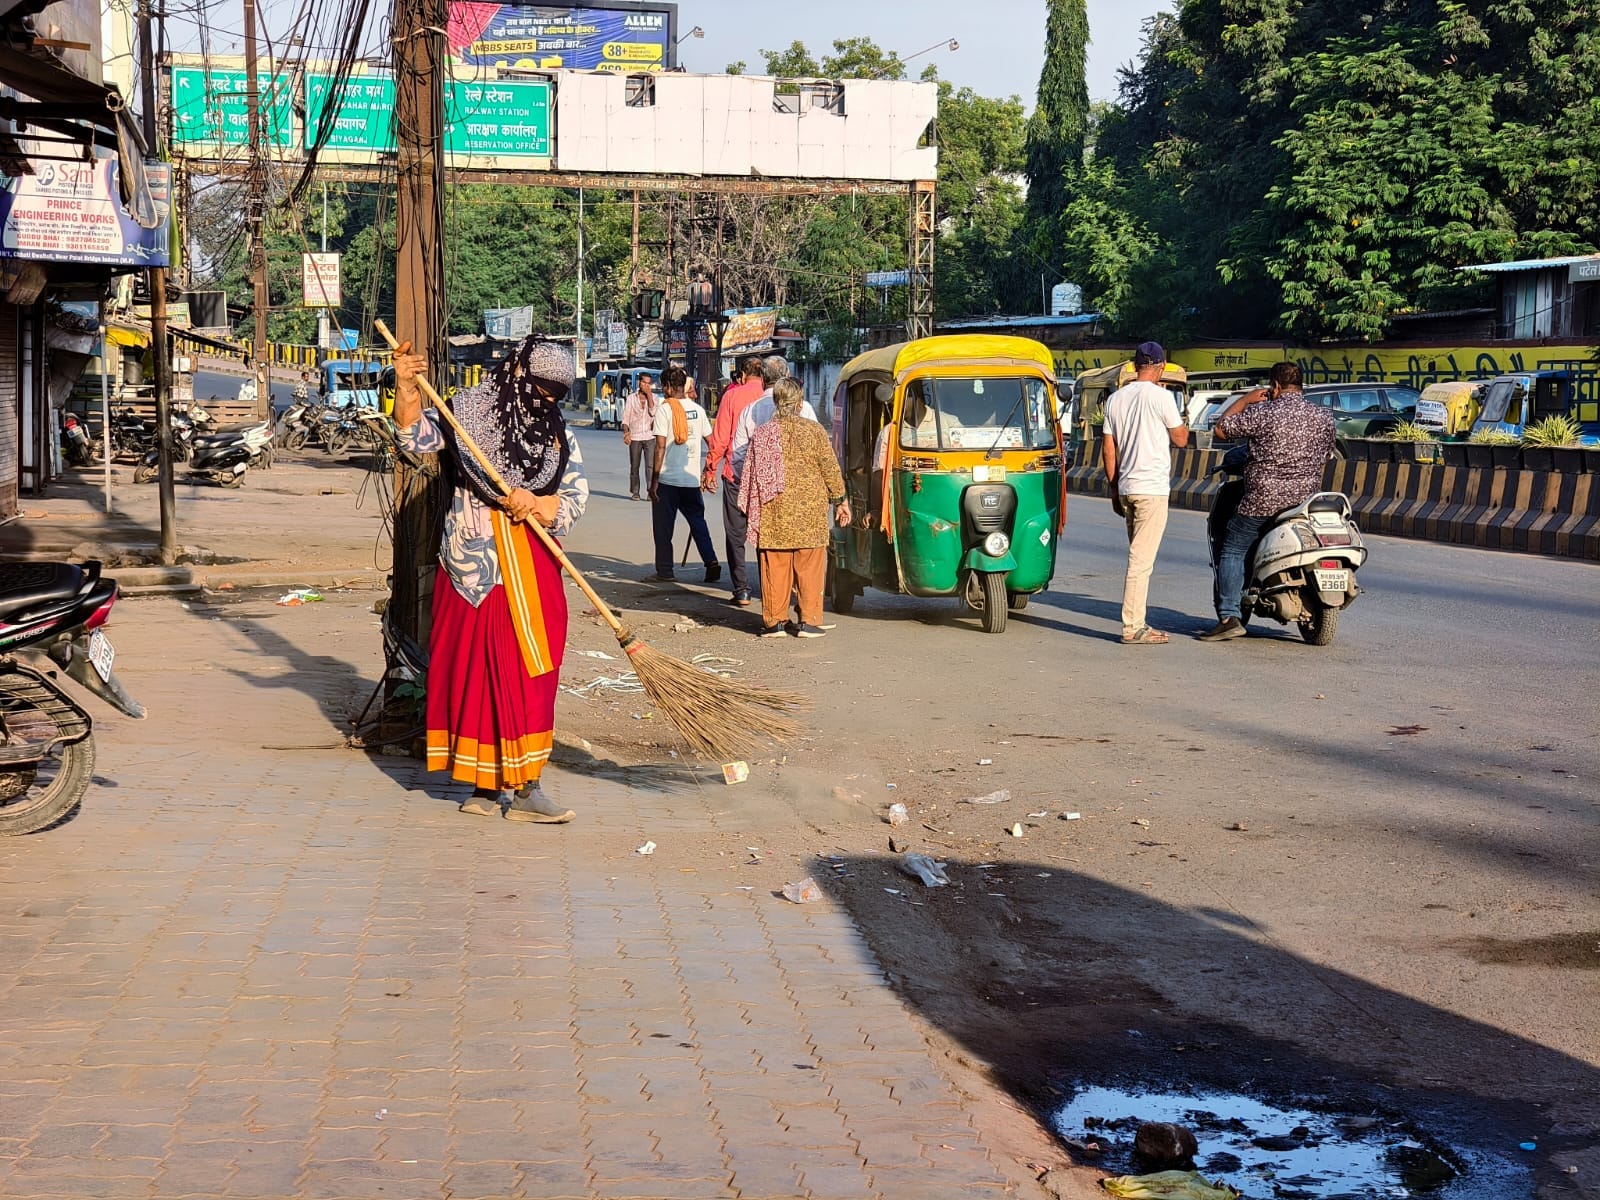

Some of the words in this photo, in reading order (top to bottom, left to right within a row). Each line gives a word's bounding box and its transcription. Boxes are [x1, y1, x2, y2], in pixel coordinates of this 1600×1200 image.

[623, 15, 663, 27] ALLEN
[474, 43, 502, 52] MBBS
[504, 42, 533, 51] SEATS
[485, 86, 514, 103] स्टेशन
[464, 106, 497, 116] RAILWAY
[499, 107, 530, 117] STATION
[466, 122, 498, 137] आरक्षण
[501, 121, 538, 137] कार्यालय
[330, 134, 368, 144] SIYAGANJ
[464, 140, 513, 150] RESERVATION
[515, 142, 540, 150] OFFICE
[58, 163, 94, 184] Sam
[47, 200, 82, 210] PRINCE
[13, 209, 78, 222] ENGINEERING
[81, 213, 115, 225] WORKS
[1579, 261, 1598, 277] पटेल
[1321, 580, 1346, 590] 2368
